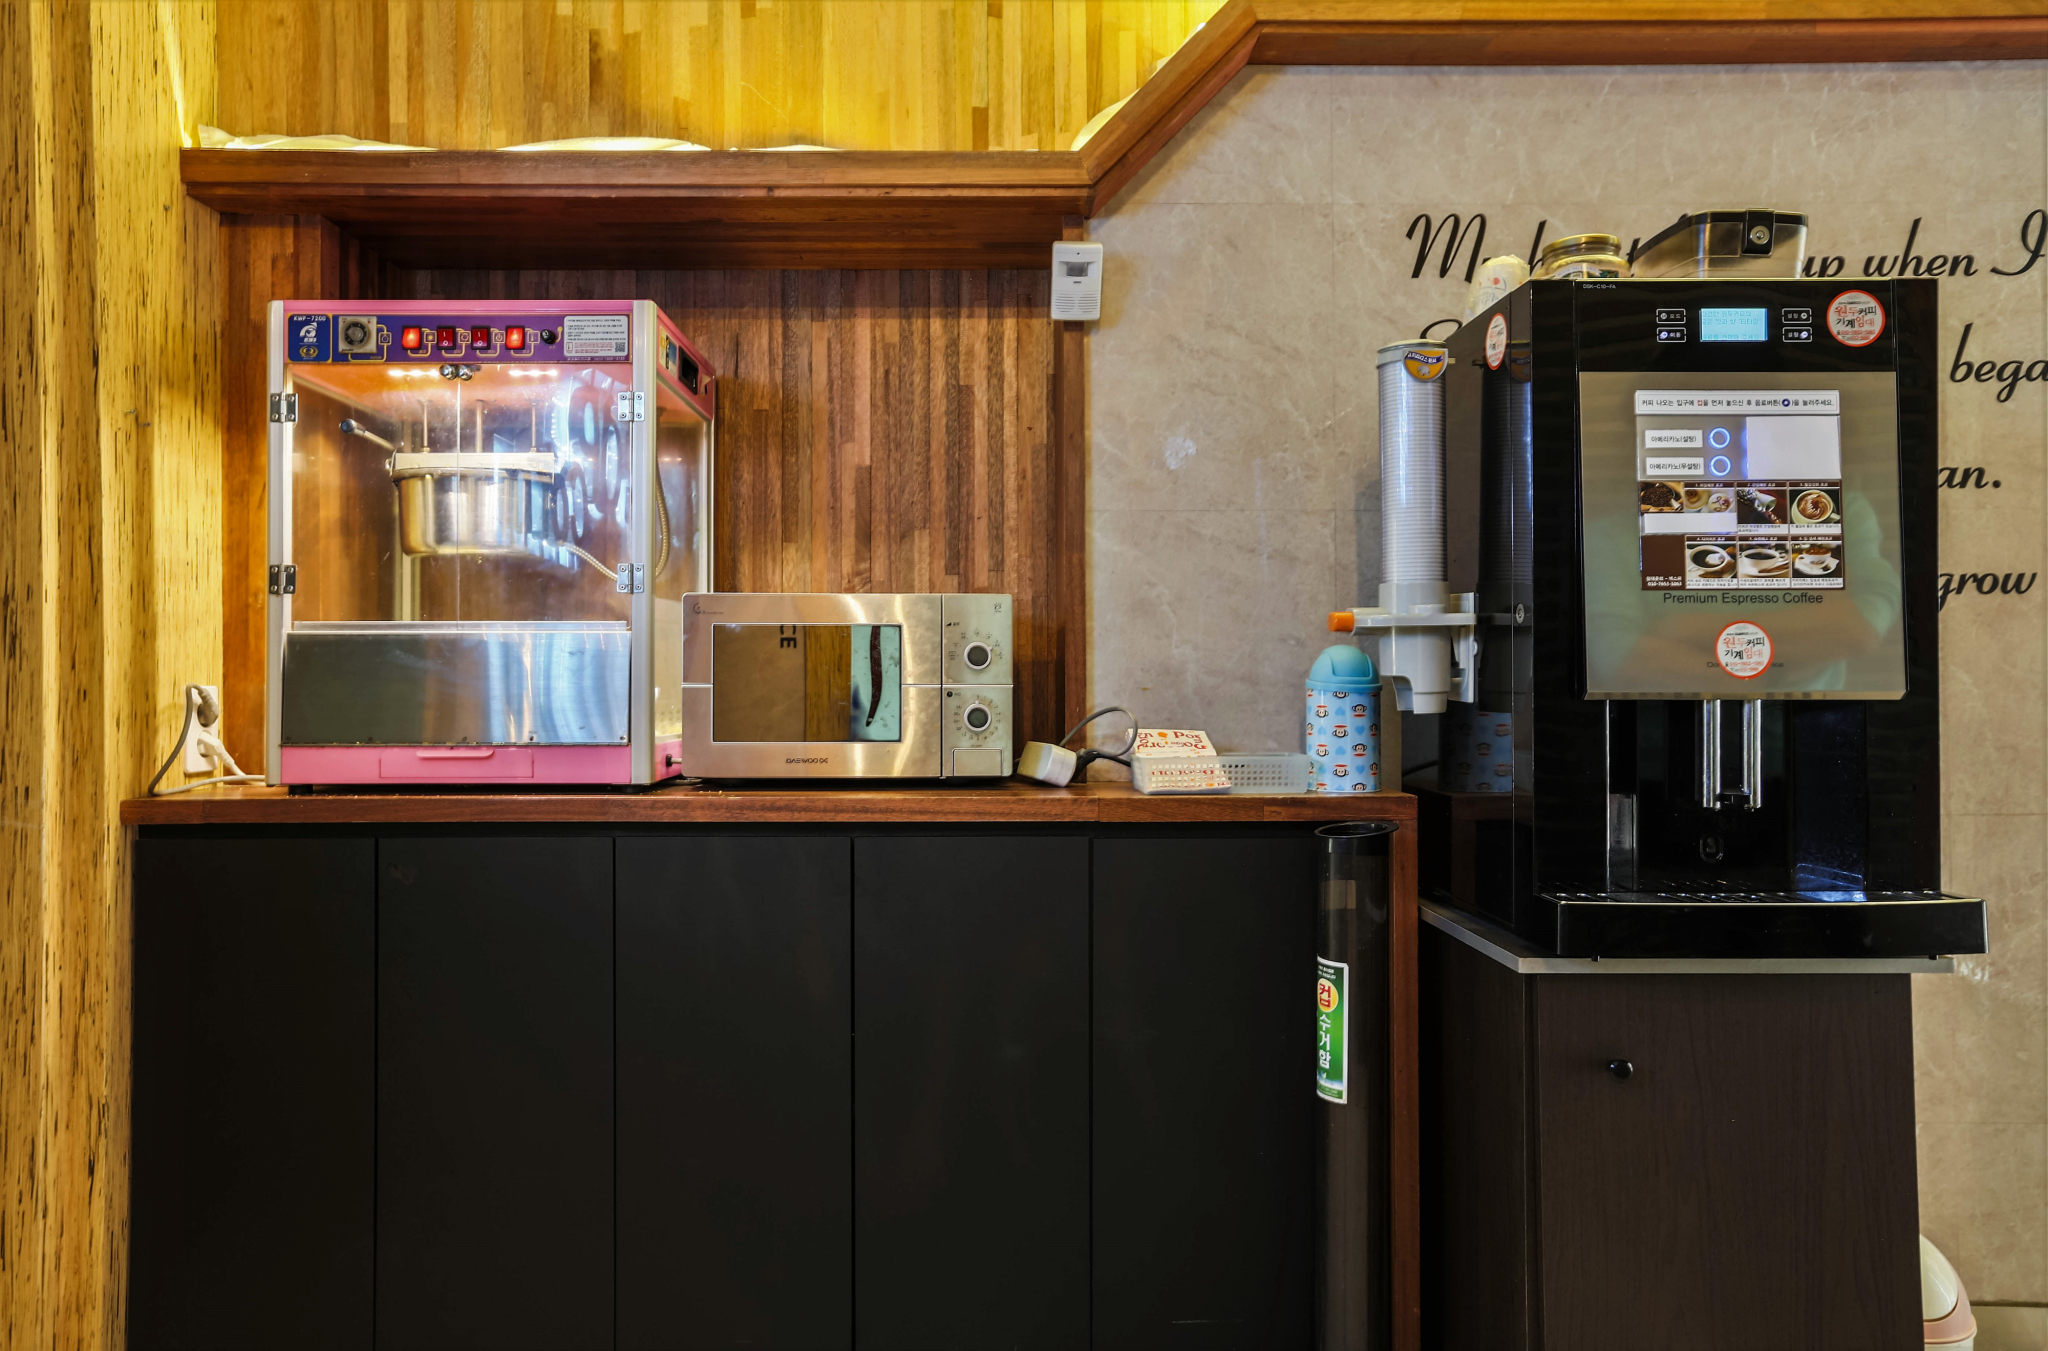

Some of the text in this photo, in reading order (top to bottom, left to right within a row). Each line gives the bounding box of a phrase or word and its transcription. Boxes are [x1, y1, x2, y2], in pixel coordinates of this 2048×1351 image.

[1405, 213, 1491, 284] M
[1863, 217, 1979, 277] when
[1989, 208, 2048, 276] I
[1834, 305, 1877, 317] 원두커피
[1836, 315, 1875, 328] 기계임대
[1949, 322, 2048, 403] bega
[1642, 398, 1654, 407] 커피
[1656, 398, 1674, 407] 나오는
[1676, 398, 1695, 407] 입구에
[1697, 398, 1709, 407] 컵을
[1711, 398, 1724, 407] 먼저
[1746, 398, 1752, 407] 후
[1650, 435, 1697, 443] 아메리카노(설탕)
[1649, 462, 1702, 471] 아메리카노(무설탕)
[1938, 571, 2039, 612] grow
[1663, 592, 1824, 607] Premium Espresso Coffee
[1723, 636, 1766, 648] 원두커피
[1725, 646, 1763, 660] 기계임대
[1319, 983, 1332, 1008] 컵
[1319, 1013, 1331, 1069] 수거함
